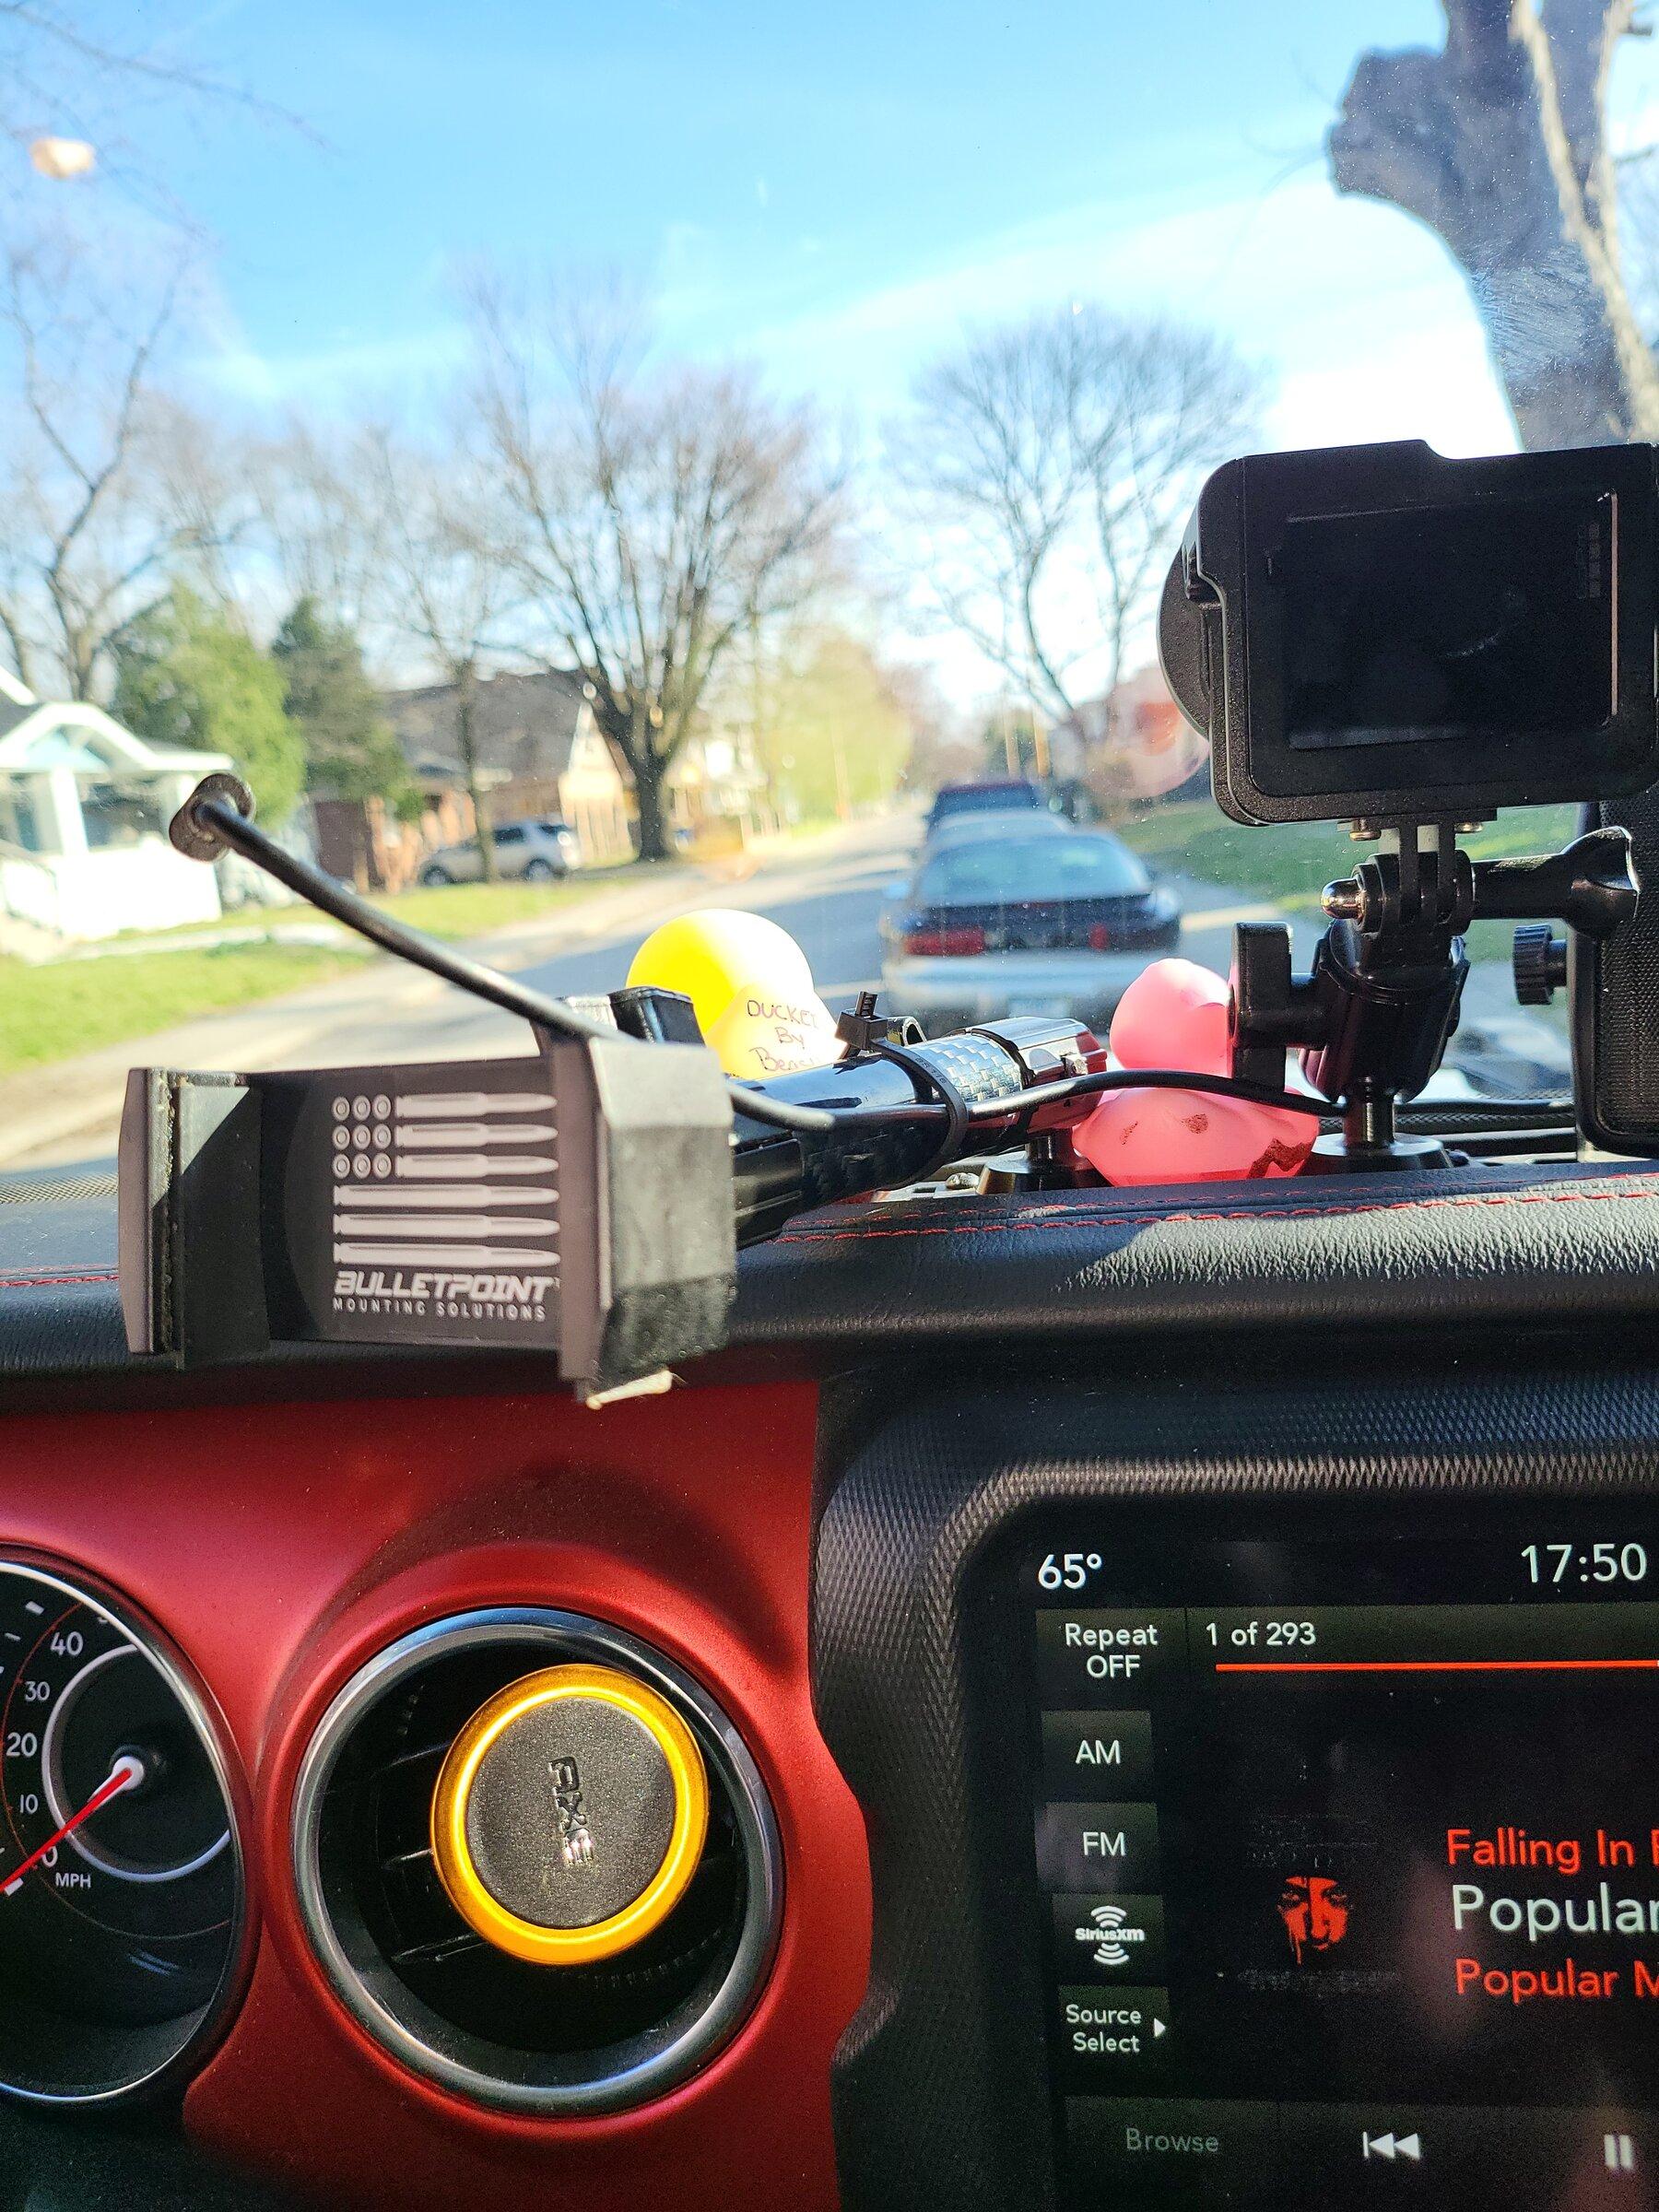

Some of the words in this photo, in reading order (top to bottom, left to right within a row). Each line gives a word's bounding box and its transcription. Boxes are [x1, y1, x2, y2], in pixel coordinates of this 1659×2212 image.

[774, 1026, 806, 1050] By
[334, 1270, 554, 1303] BULLETPOINT
[333, 1298, 427, 1316] MOUNTING
[435, 1301, 547, 1322] SOLUTIONS
[1520, 1543, 1648, 1584] 17:50
[50, 1630, 84, 1656] 40
[1064, 1622, 1159, 1651] Repeat
[1206, 1622, 1218, 1647] 1
[1230, 1621, 1259, 1646] of
[1265, 1621, 1317, 1646] 293
[1086, 1654, 1141, 1678] OFF
[24, 1680, 51, 1701] 30
[6, 1732, 38, 1759] 20
[1075, 1739, 1122, 1765] AM
[19, 1794, 39, 1815] 10
[1082, 1831, 1126, 1857] FM
[1446, 1827, 1582, 1876] Falling
[1596, 1829, 1635, 1867] In
[55, 1872, 92, 1888] MPH
[1454, 1958, 1619, 2006] Popular
[1065, 2003, 1142, 2025] Source
[1072, 2031, 1140, 2053] Select
[1125, 2127, 1220, 2153] Browse
